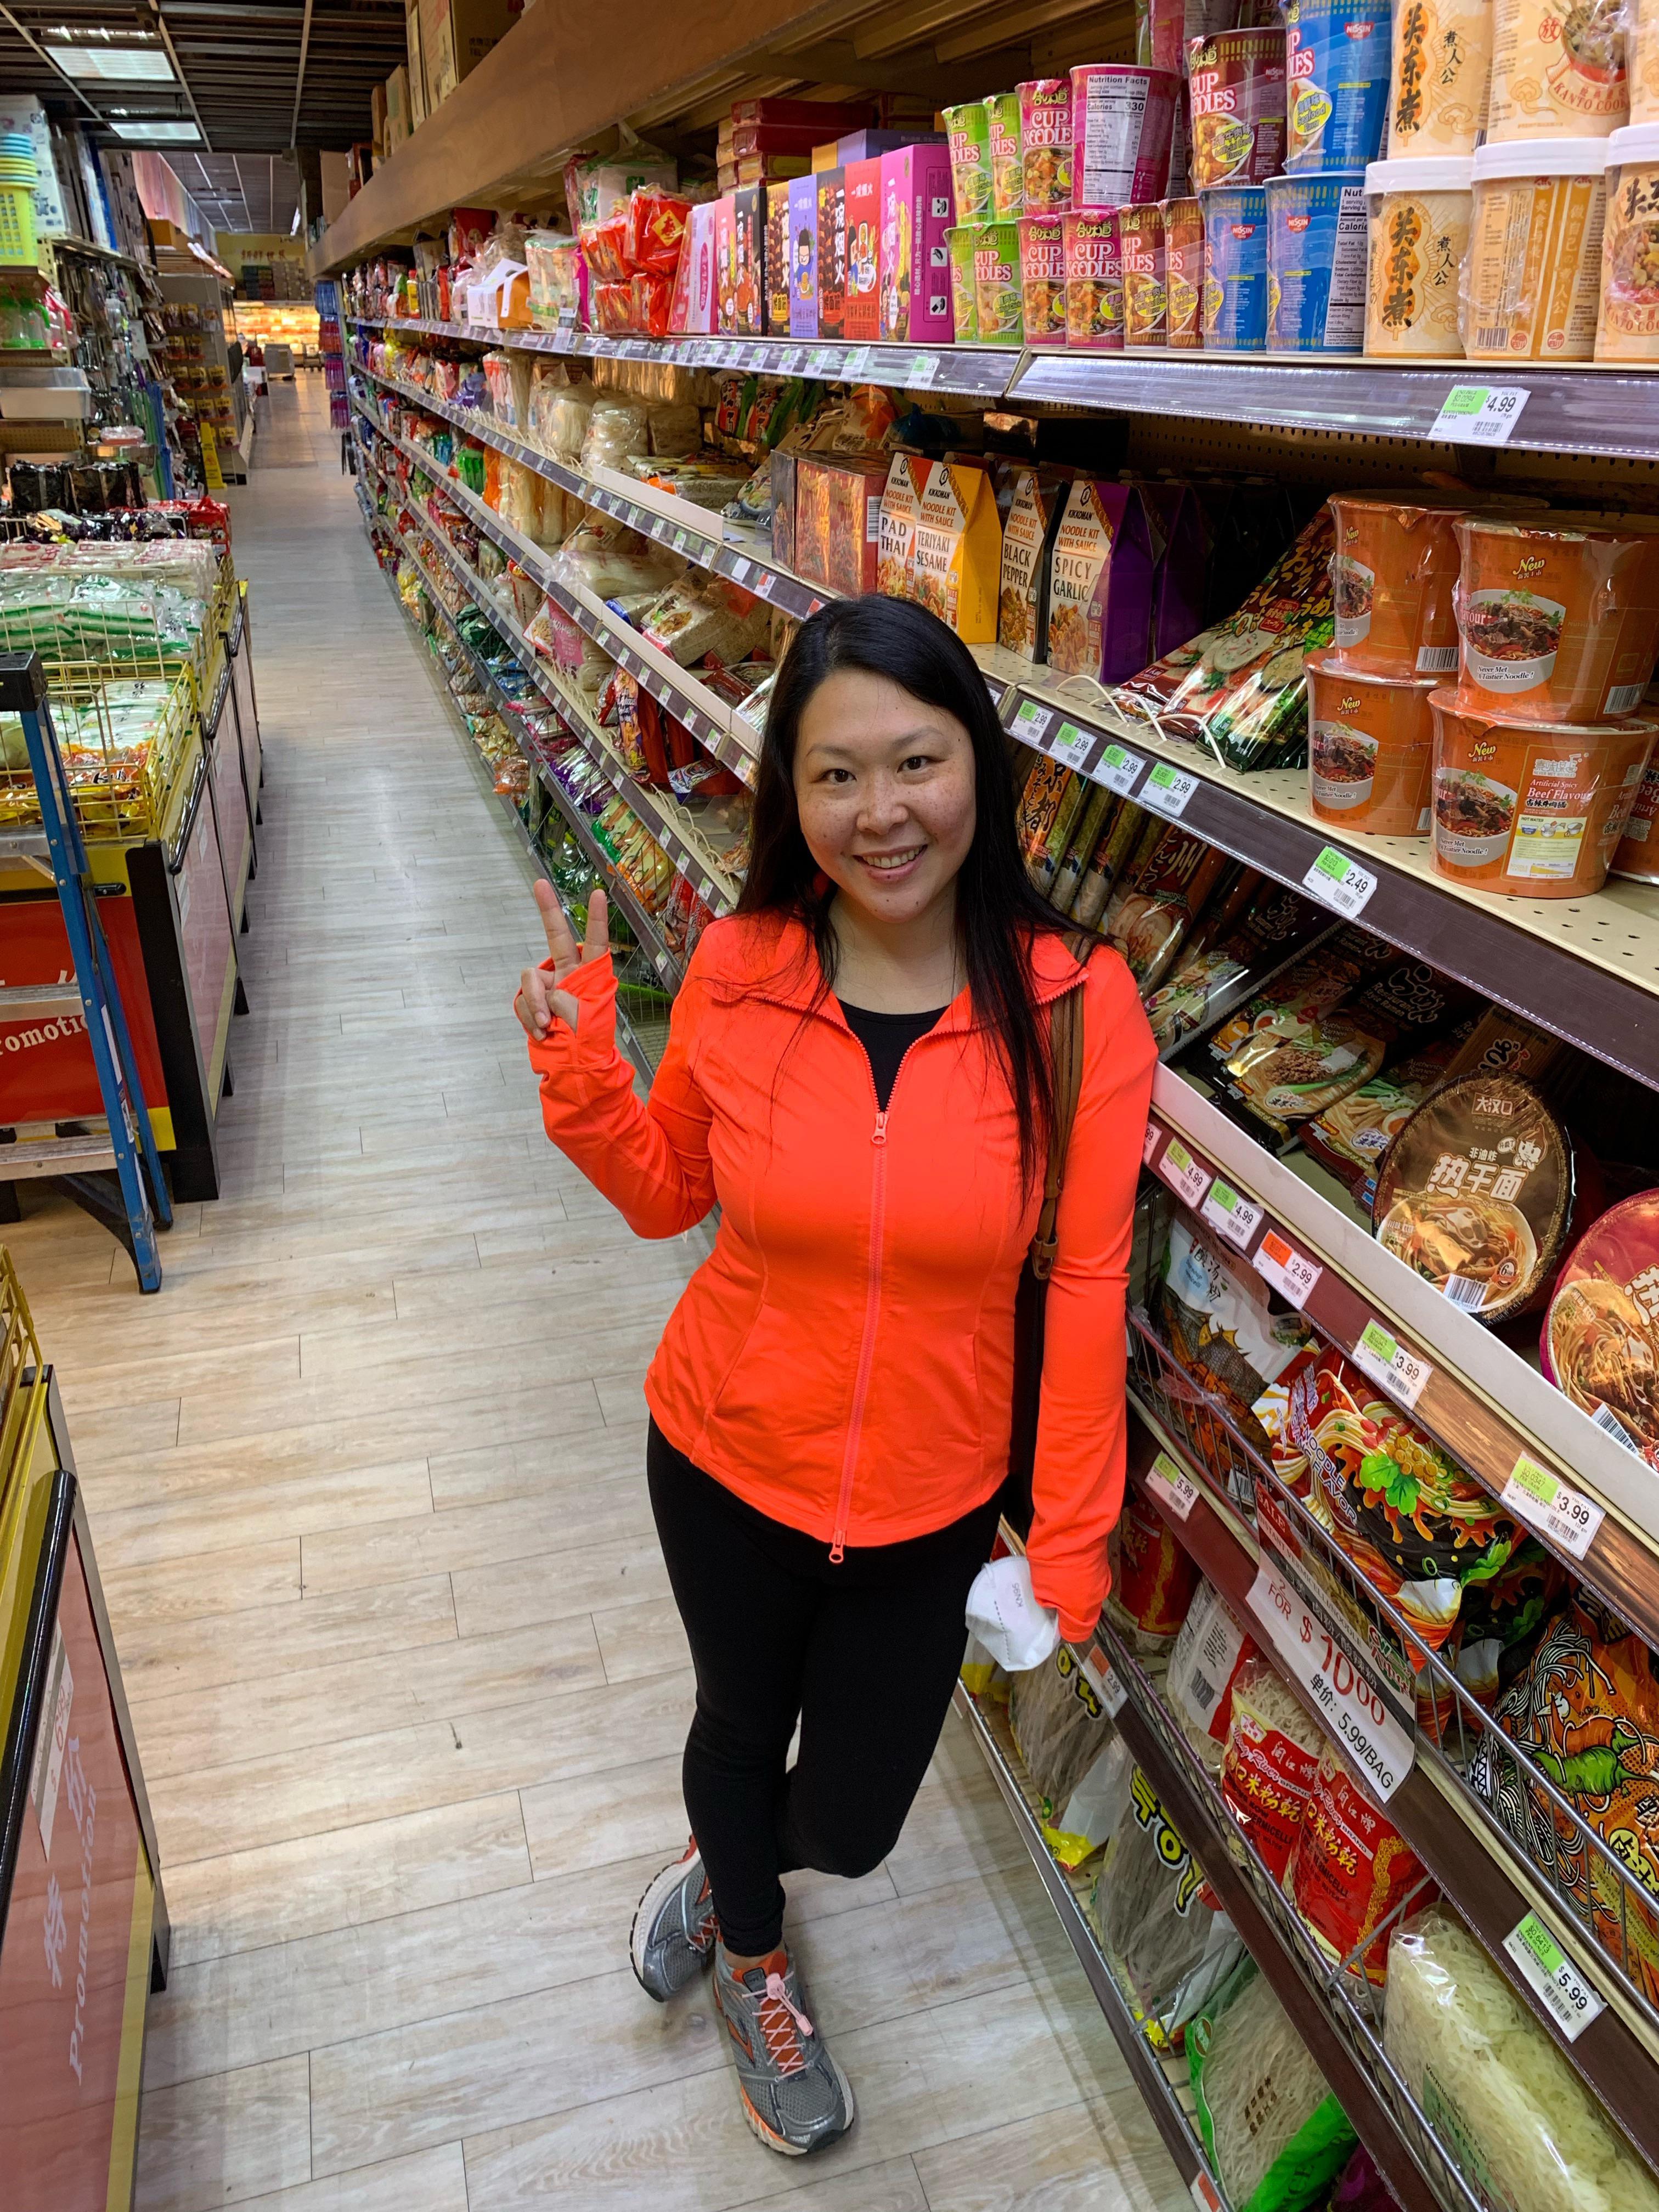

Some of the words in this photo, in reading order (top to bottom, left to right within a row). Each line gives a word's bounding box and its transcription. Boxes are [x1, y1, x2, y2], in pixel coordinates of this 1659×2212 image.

[1346, 24, 1372, 33] NISSIN
[1440, 31, 1462, 84] 煮人公
[1191, 72, 1220, 97] CUP
[1125, 101, 1144, 111] 330
[1554, 82, 1593, 110] KANTO
[1032, 110, 1069, 128] CUP
[1297, 105, 1326, 125] Seafood
[1023, 127, 1073, 148] NOODLE
[1289, 218, 1308, 227] NISSIN
[974, 250, 1000, 267] CUP
[1028, 245, 1063, 263] CUP
[1075, 242, 1113, 261] CUP
[1433, 236, 1455, 286] 煮人公
[891, 477, 909, 488] KIKKOMAN
[885, 489, 905, 502] NOODLE
[906, 494, 914, 504] KIT
[928, 488, 951, 500] KIKKOMAN
[1015, 498, 1034, 510] KIKKOMAN
[883, 500, 896, 511] WITH
[896, 503, 912, 514] SAUCE
[922, 501, 945, 515] NOODLE
[946, 507, 957, 517] KIT
[1068, 509, 1093, 521] KIKKOMAN
[881, 517, 907, 537] PAD
[921, 512, 934, 524] WITH
[935, 516, 954, 528] SAUCE
[1011, 512, 1029, 526] NOODLE
[918, 530, 950, 553] TERIYAKI
[1008, 524, 1019, 536] WITH
[1020, 528, 1035, 541] SAUCE
[1061, 524, 1087, 538] NOODLE
[1088, 529, 1100, 540] KIT
[1344, 527, 1359, 543] New
[881, 535, 905, 556] THAI
[1058, 535, 1075, 549] WITH
[1076, 539, 1097, 552] SAUCE
[917, 550, 947, 572] SESAME
[1004, 543, 1030, 568] BLACK
[1513, 556, 1545, 575] New
[1003, 563, 1028, 588] PEPPER
[1054, 556, 1092, 580] SPICY
[1053, 578, 1089, 603] GARLIC
[1337, 697, 1361, 712] New
[1468, 742, 1497, 758] New
[1527, 787, 1553, 798] Beef
[1554, 788, 1594, 800] Flavour
[1531, 778, 1559, 787] Artificial
[1561, 780, 1579, 789] Spicy
[1462, 847, 1483, 855] Noodle
[1346, 869, 1368, 894] $2.49
[1374, 982, 1418, 1012] Restaurant
[1475, 1096, 1513, 1116] 大汉口
[1469, 1147, 1498, 1163] 非油炸
[1427, 1154, 1528, 1201] 热干面
[1292, 1259, 1312, 1284] $2.99
[1395, 1351, 1419, 1380] $3.99
[1302, 1426, 1346, 1492] NOODLE
[1313, 1460, 1358, 1526] FLAVOR
[1257, 1493, 1286, 1533] SALE
[1556, 1491, 1590, 1525] $3.99
[1012, 1583, 1024, 1608] KN95
[1268, 1583, 1292, 1622] FOR
[1338, 1712, 1394, 1790] 5.99/BAG
[1251, 1747, 1280, 1781] River
[1280, 1779, 1311, 1798] BRAND
[1320, 1787, 1343, 1828] River
[1341, 1824, 1368, 1854] BRAND
[43, 1733, 87, 1989] 特价
[69, 1784, 97, 2085] Promotion
[1558, 1965, 1588, 2011] $5.99
